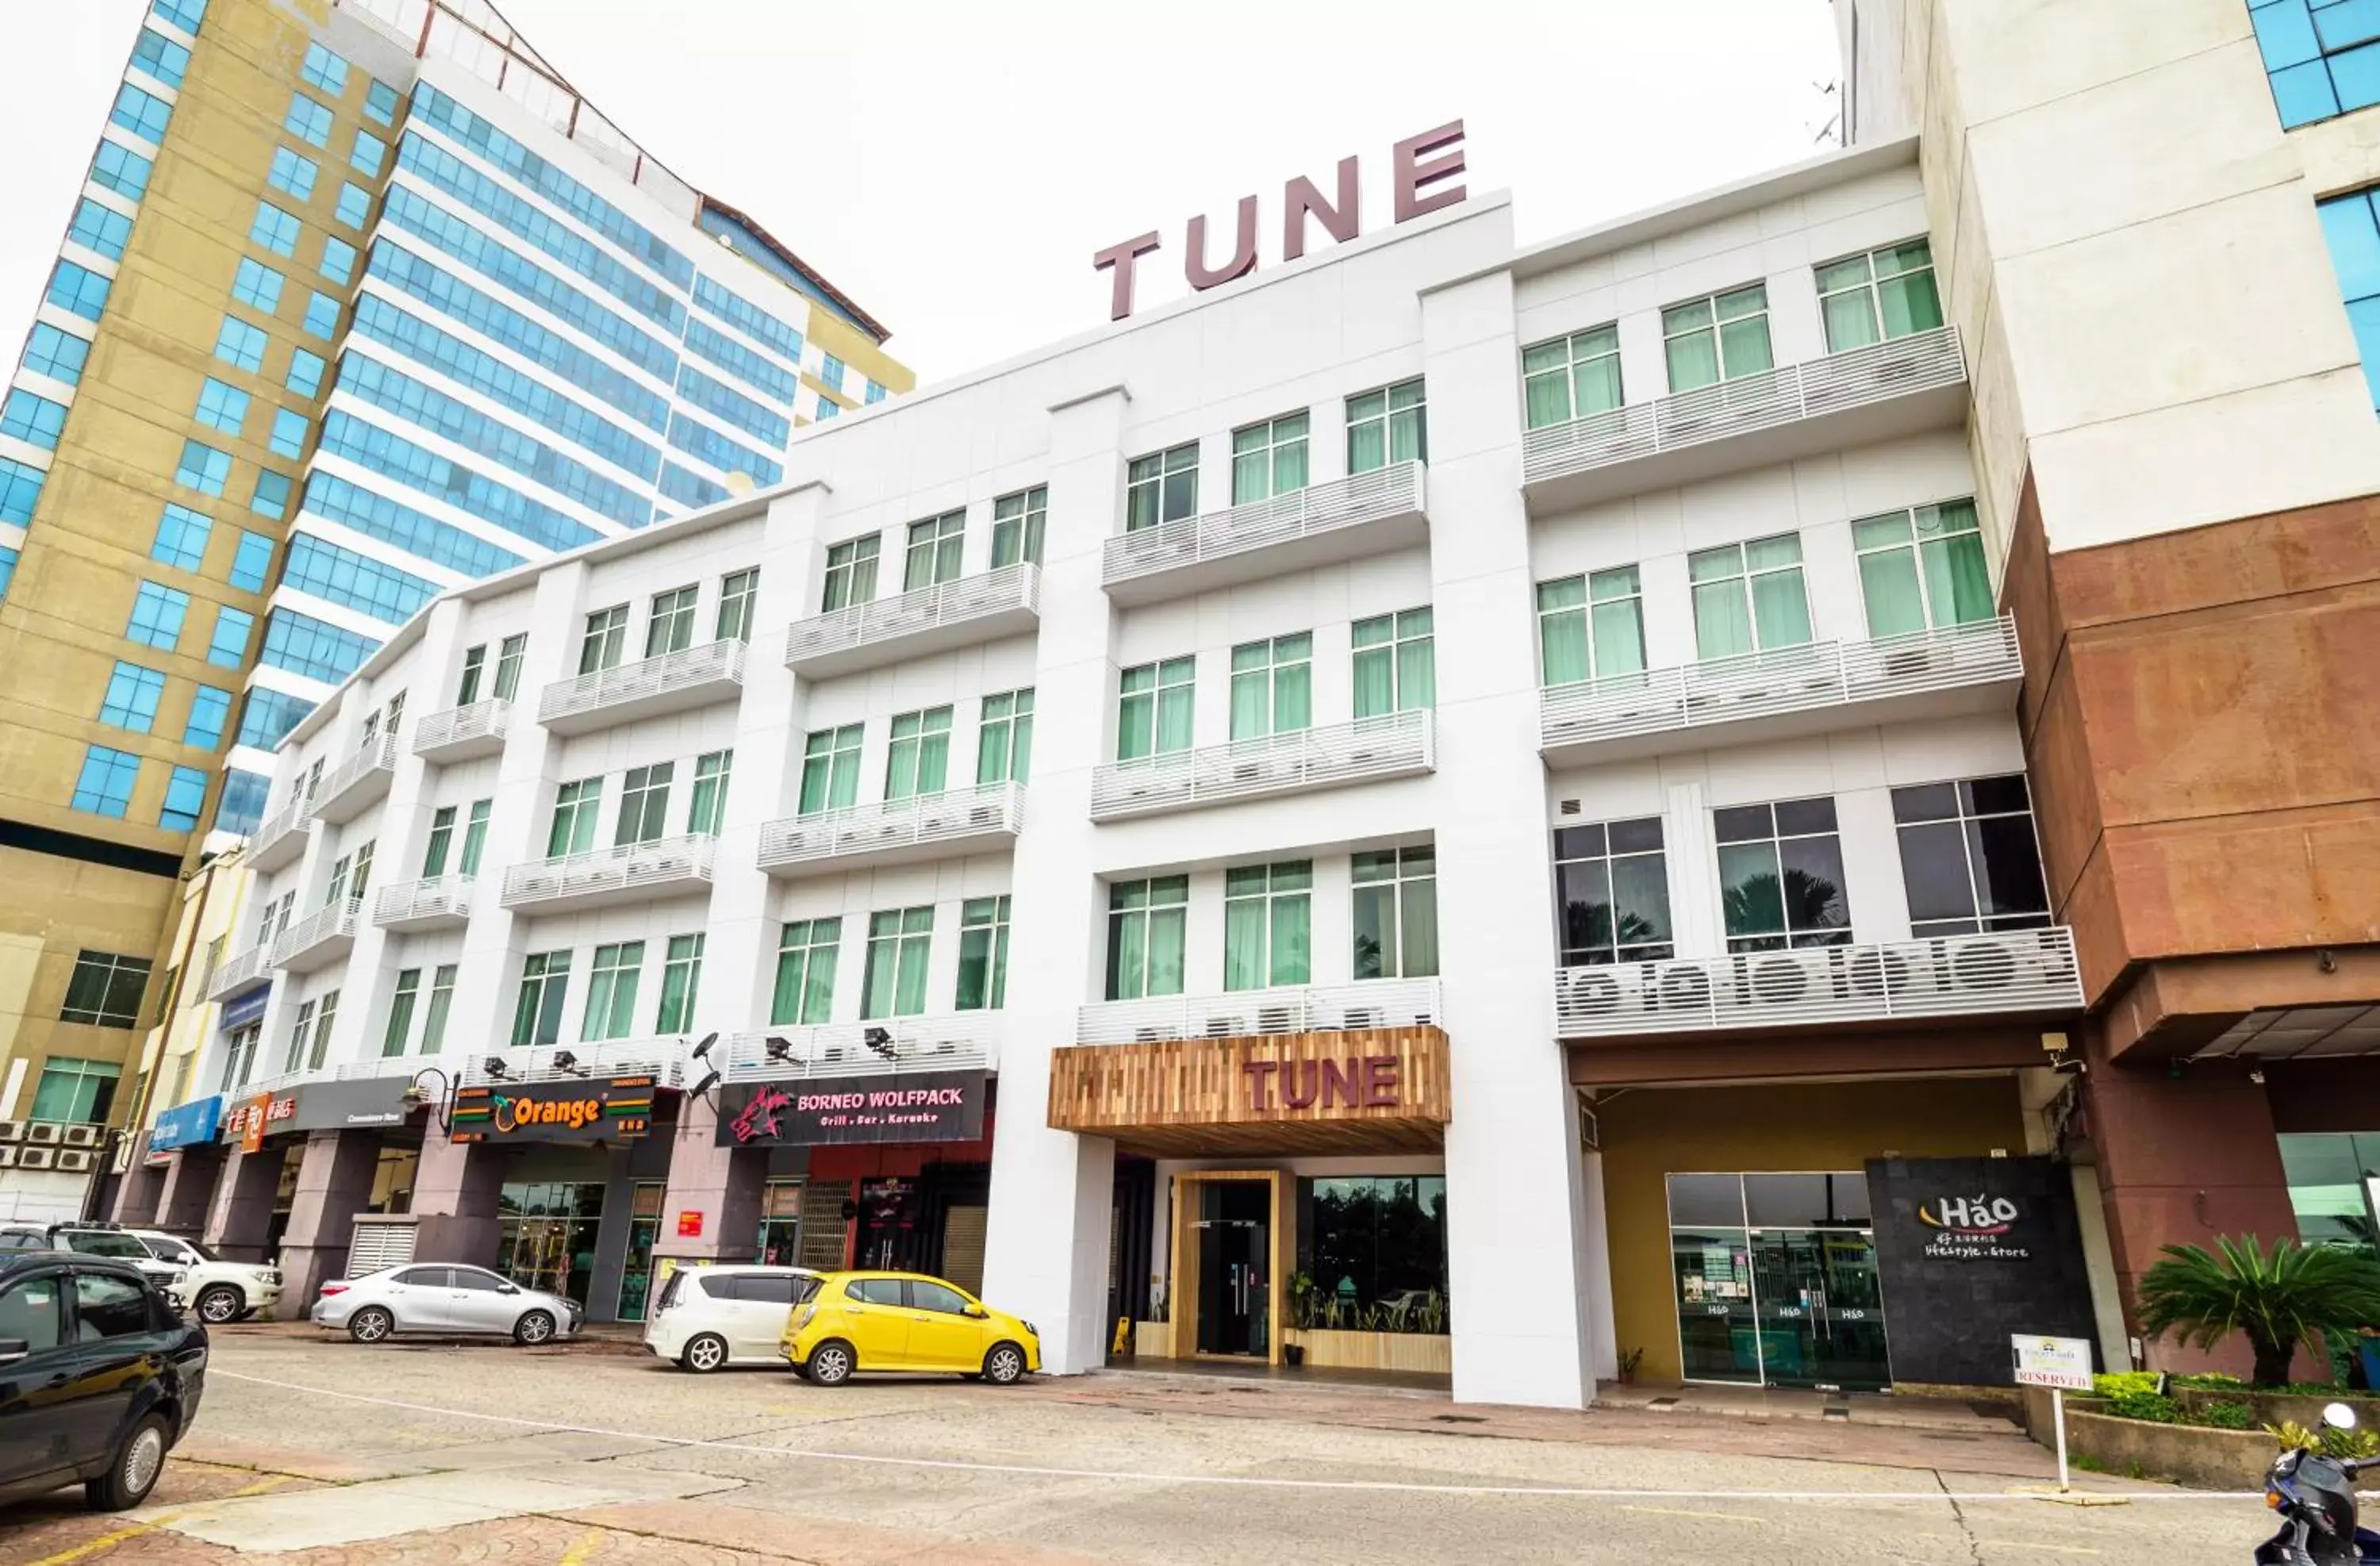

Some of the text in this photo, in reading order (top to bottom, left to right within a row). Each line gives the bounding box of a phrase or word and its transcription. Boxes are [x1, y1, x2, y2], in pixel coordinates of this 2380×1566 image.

[1093, 118, 1467, 321] TUNE
[1242, 1056, 1399, 1111] TUNE
[515, 1097, 600, 1129] Orange
[797, 1088, 963, 1111] BORNEO WOLFPACK
[820, 1112, 939, 1127] Grill Bar Karaoke
[2018, 1371, 2087, 1388] RESERVED
